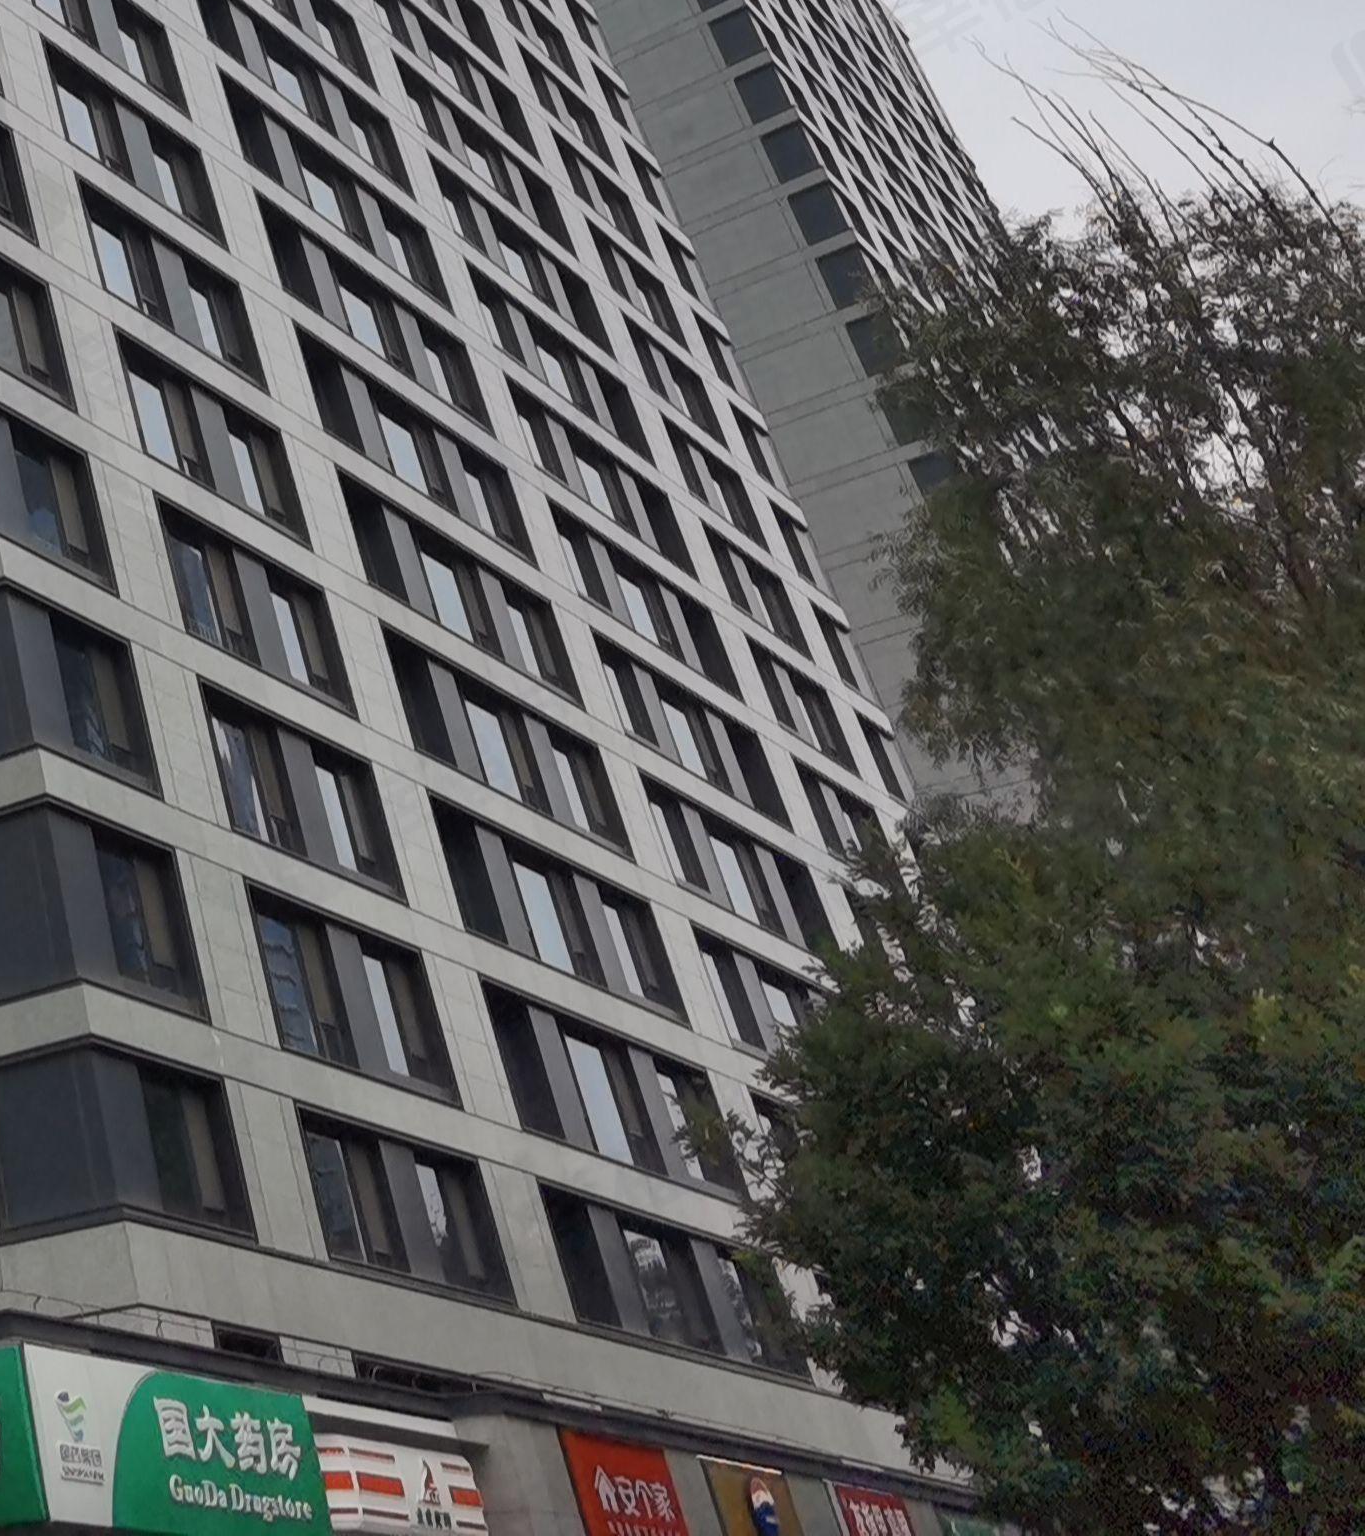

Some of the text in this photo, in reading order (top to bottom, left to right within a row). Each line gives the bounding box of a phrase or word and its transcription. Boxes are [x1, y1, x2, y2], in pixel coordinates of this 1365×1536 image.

[152, 1395, 302, 1482] 国大药房
[168, 1473, 315, 1523] GuoDa Drugstore
[612, 1475, 677, 1523] 安个家
